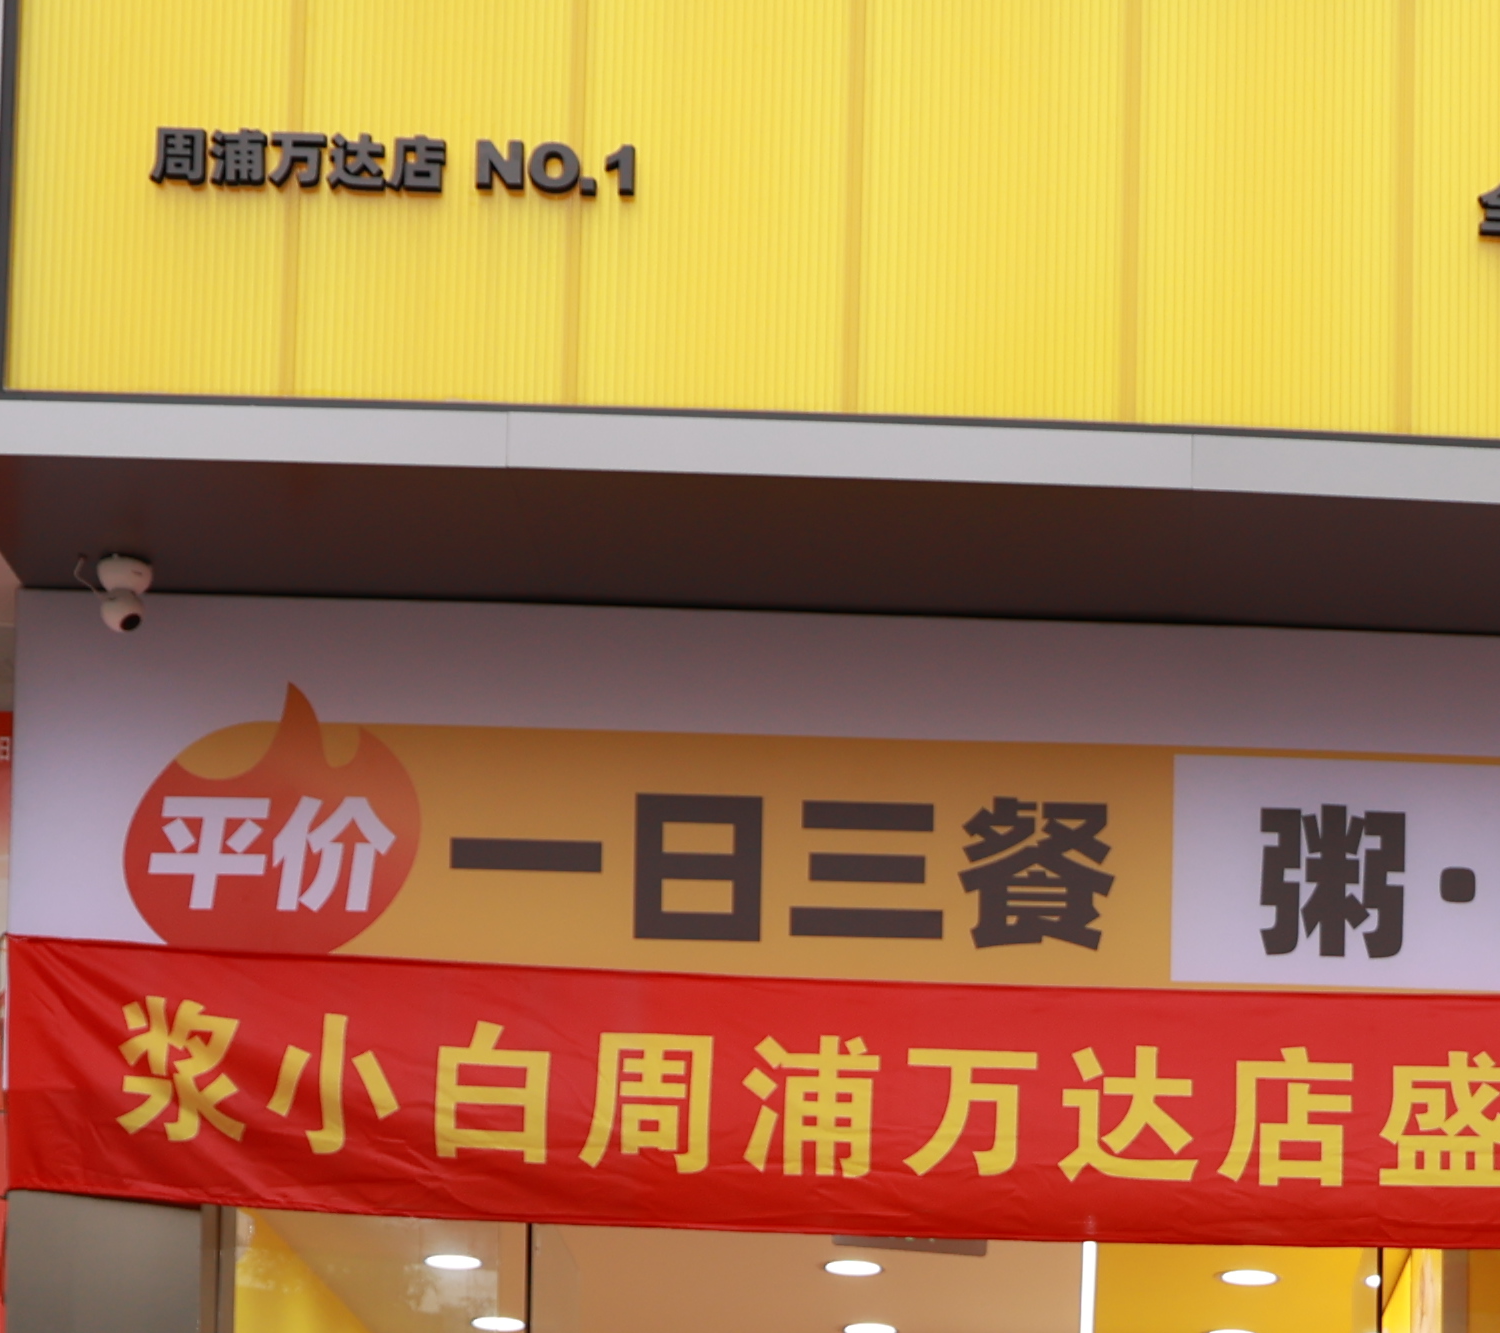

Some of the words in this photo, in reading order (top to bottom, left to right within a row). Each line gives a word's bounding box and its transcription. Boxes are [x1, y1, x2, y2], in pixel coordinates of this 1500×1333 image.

[149, 124, 448, 197] 周浦万达店
[474, 138, 638, 202] NO.1
[147, 794, 397, 913] 平价
[449, 791, 1116, 953] 一日三餐
